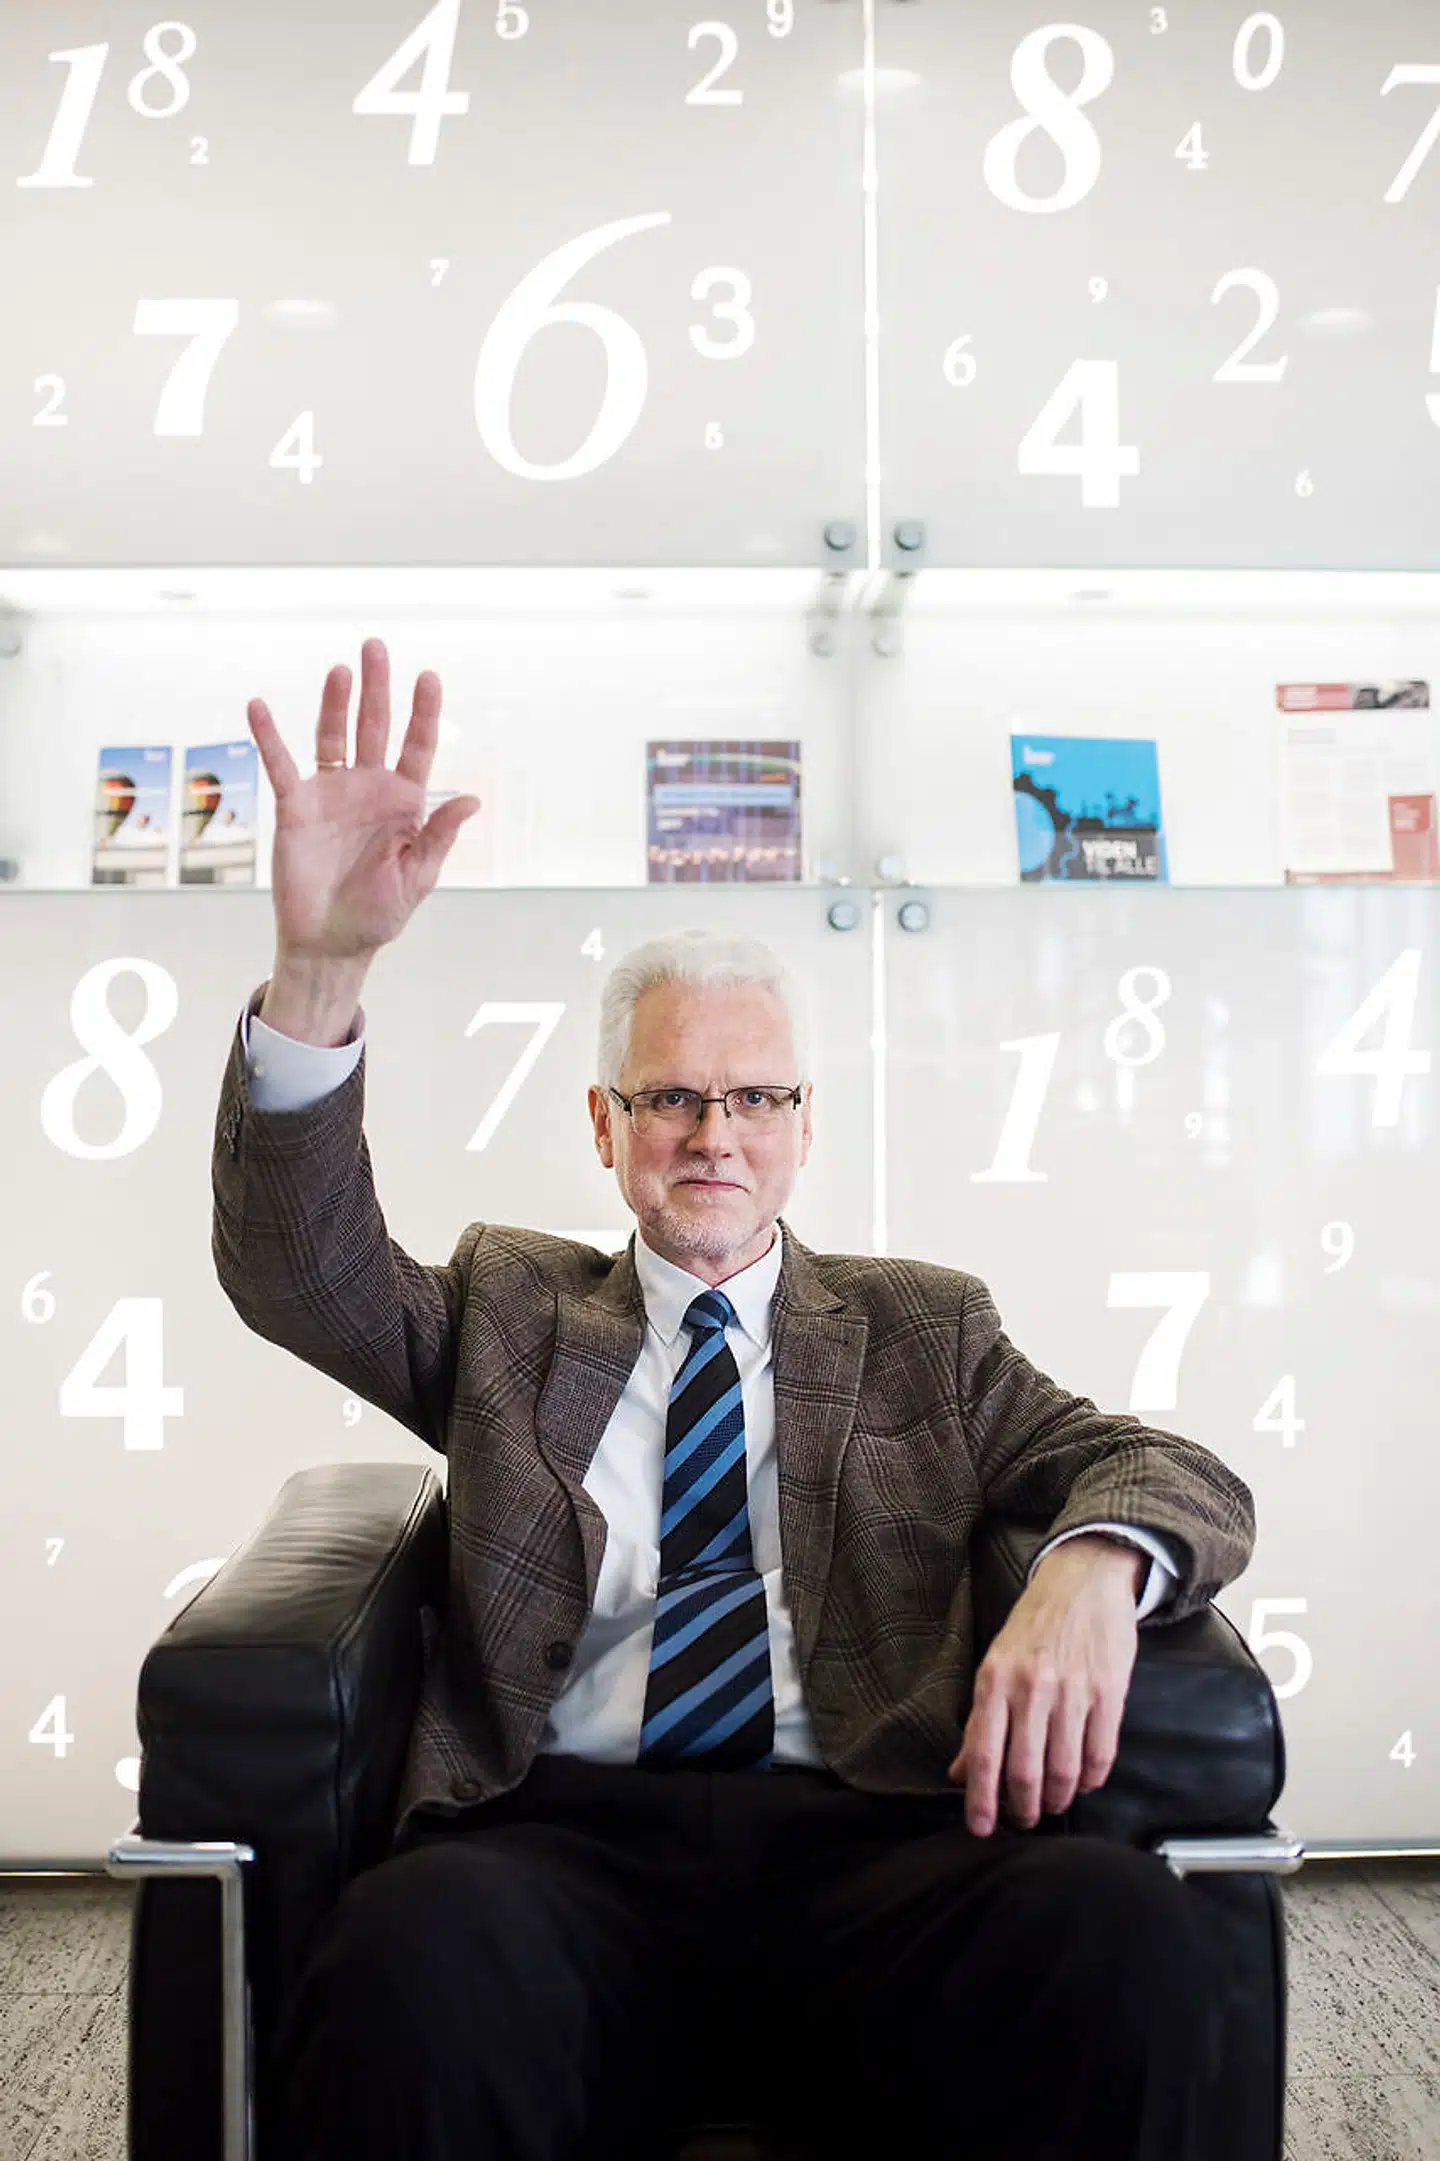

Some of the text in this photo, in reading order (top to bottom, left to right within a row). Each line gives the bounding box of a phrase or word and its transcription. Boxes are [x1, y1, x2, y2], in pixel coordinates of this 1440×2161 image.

[767, 0, 794, 38] 9
[1151, 7, 1169, 34] 3
[1232, 11, 1284, 91] 0
[127, 21, 197, 119] 8
[352, 0, 469, 166] 4
[685, 21, 743, 106] 2
[16, 43, 109, 189] 1
[191, 135, 209, 165] 2
[983, 23, 1114, 214] 8
[1175, 122, 1209, 170] 4
[1380, 64, 1440, 203] 7
[430, 259, 449, 286] 7
[1088, 277, 1108, 303] 9
[474, 212, 671, 481] 6
[690, 266, 755, 361] 3
[1211, 267, 1288, 383] 2
[32, 373, 68, 426] 2
[133, 298, 239, 436] 7
[943, 334, 977, 386] 6
[269, 410, 322, 484] 4
[1017, 359, 1141, 508] 4
[1295, 470, 1313, 497] 6
[580, 928, 605, 961] 4
[1104, 966, 1171, 1066] 8
[1316, 949, 1431, 1128] 4
[41, 957, 179, 1160] 8
[465, 1002, 566, 1153] 7
[972, 1031, 1061, 1183] 1
[1185, 1112, 1203, 1139] 9
[1320, 1220, 1355, 1273] 9
[21, 1270, 56, 1324] 6
[60, 1297, 184, 1451] 4
[1105, 1271, 1211, 1411] 7
[343, 1399, 362, 1427] 9
[1252, 1375, 1305, 1448] 4
[46, 1537, 65, 1566] 7
[1249, 1597, 1313, 1699] 5
[29, 1695, 75, 1757] 4
[1389, 1730, 1417, 1768] 4
